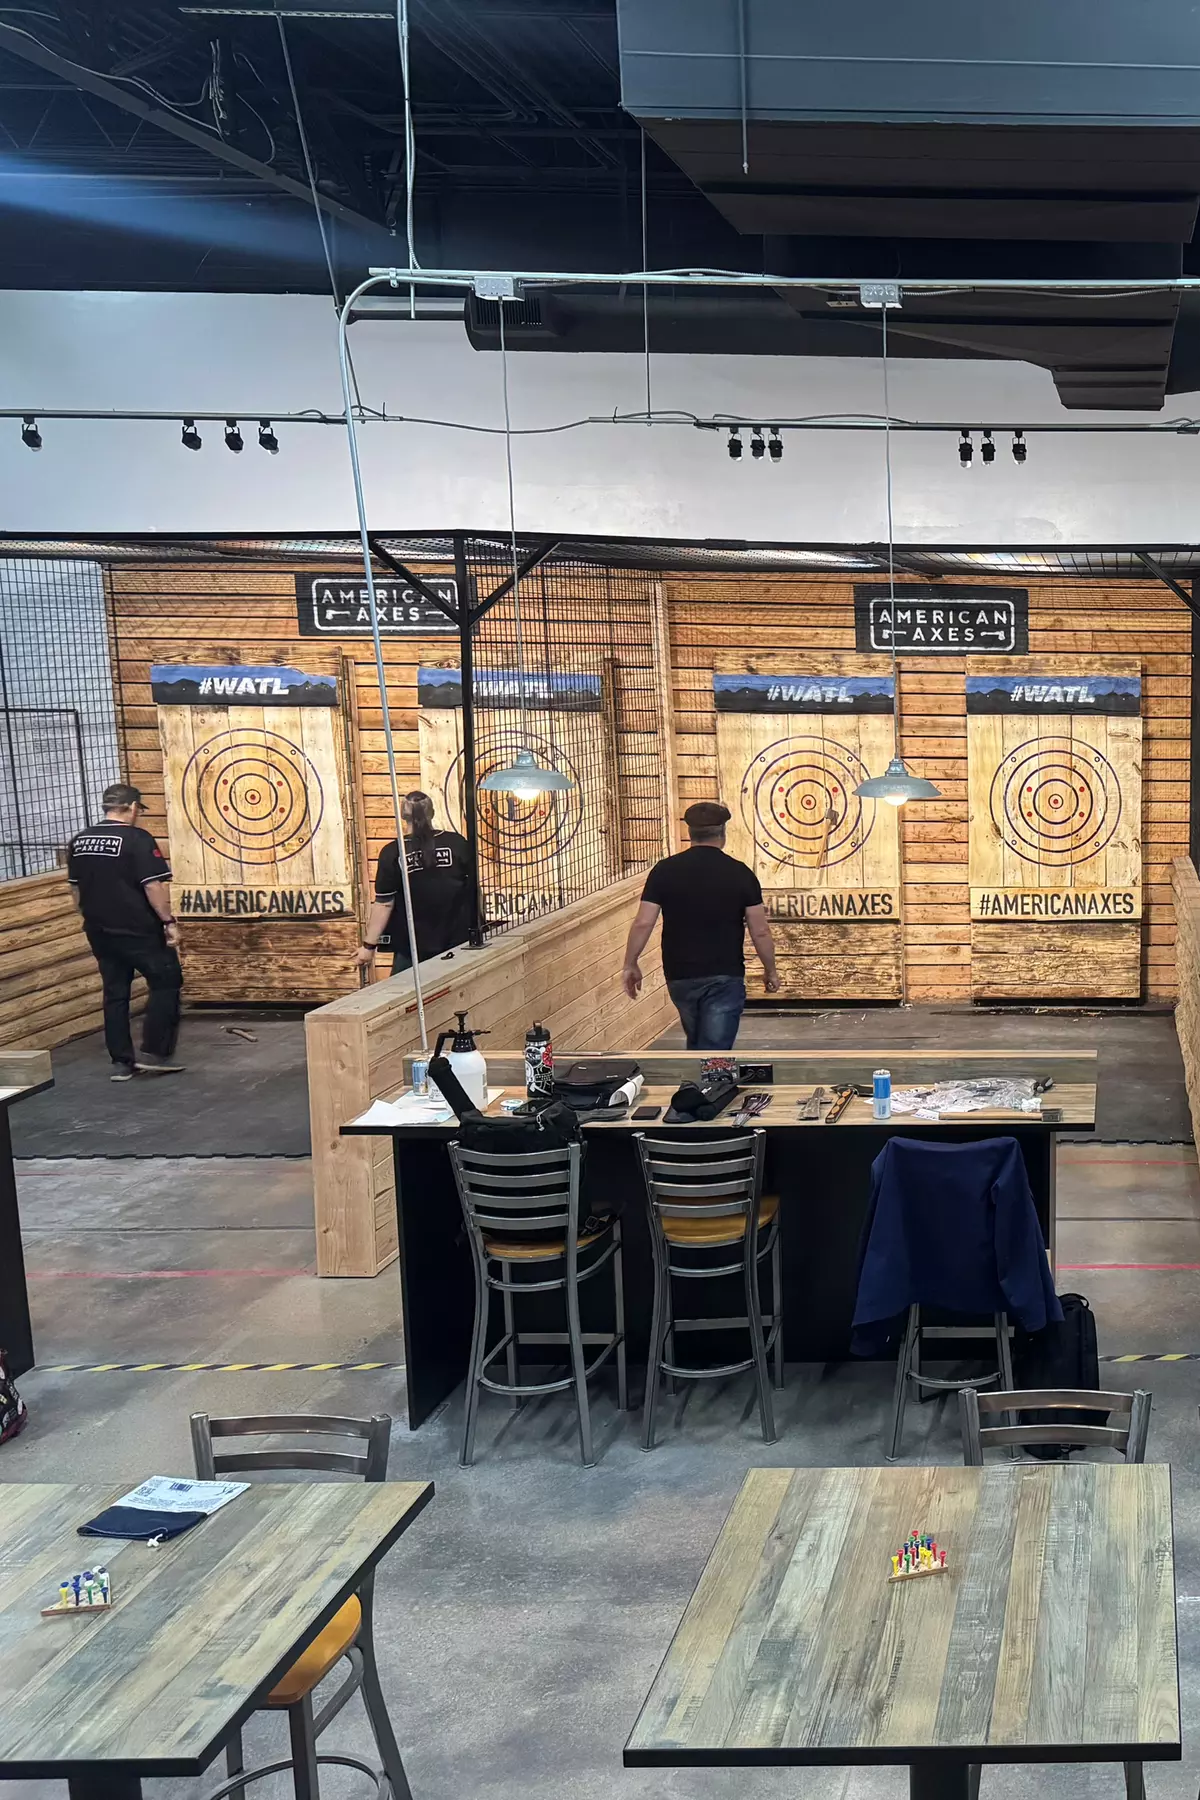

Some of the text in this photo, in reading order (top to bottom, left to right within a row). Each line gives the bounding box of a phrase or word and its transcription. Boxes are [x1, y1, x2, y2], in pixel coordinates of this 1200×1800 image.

[356, 606, 421, 622] AXES
[879, 609, 1008, 625] AMERICAN
[912, 627, 975, 642] AXES
[198, 676, 290, 696] #WATL
[766, 683, 854, 704] #WATL
[1010, 684, 1096, 704] #WATL
[73, 838, 120, 848] AMERICAN
[179, 889, 345, 914] #AMERICANAXES
[764, 893, 893, 916] MERICANAXES
[979, 892, 1135, 916] #AMERICANAXES
